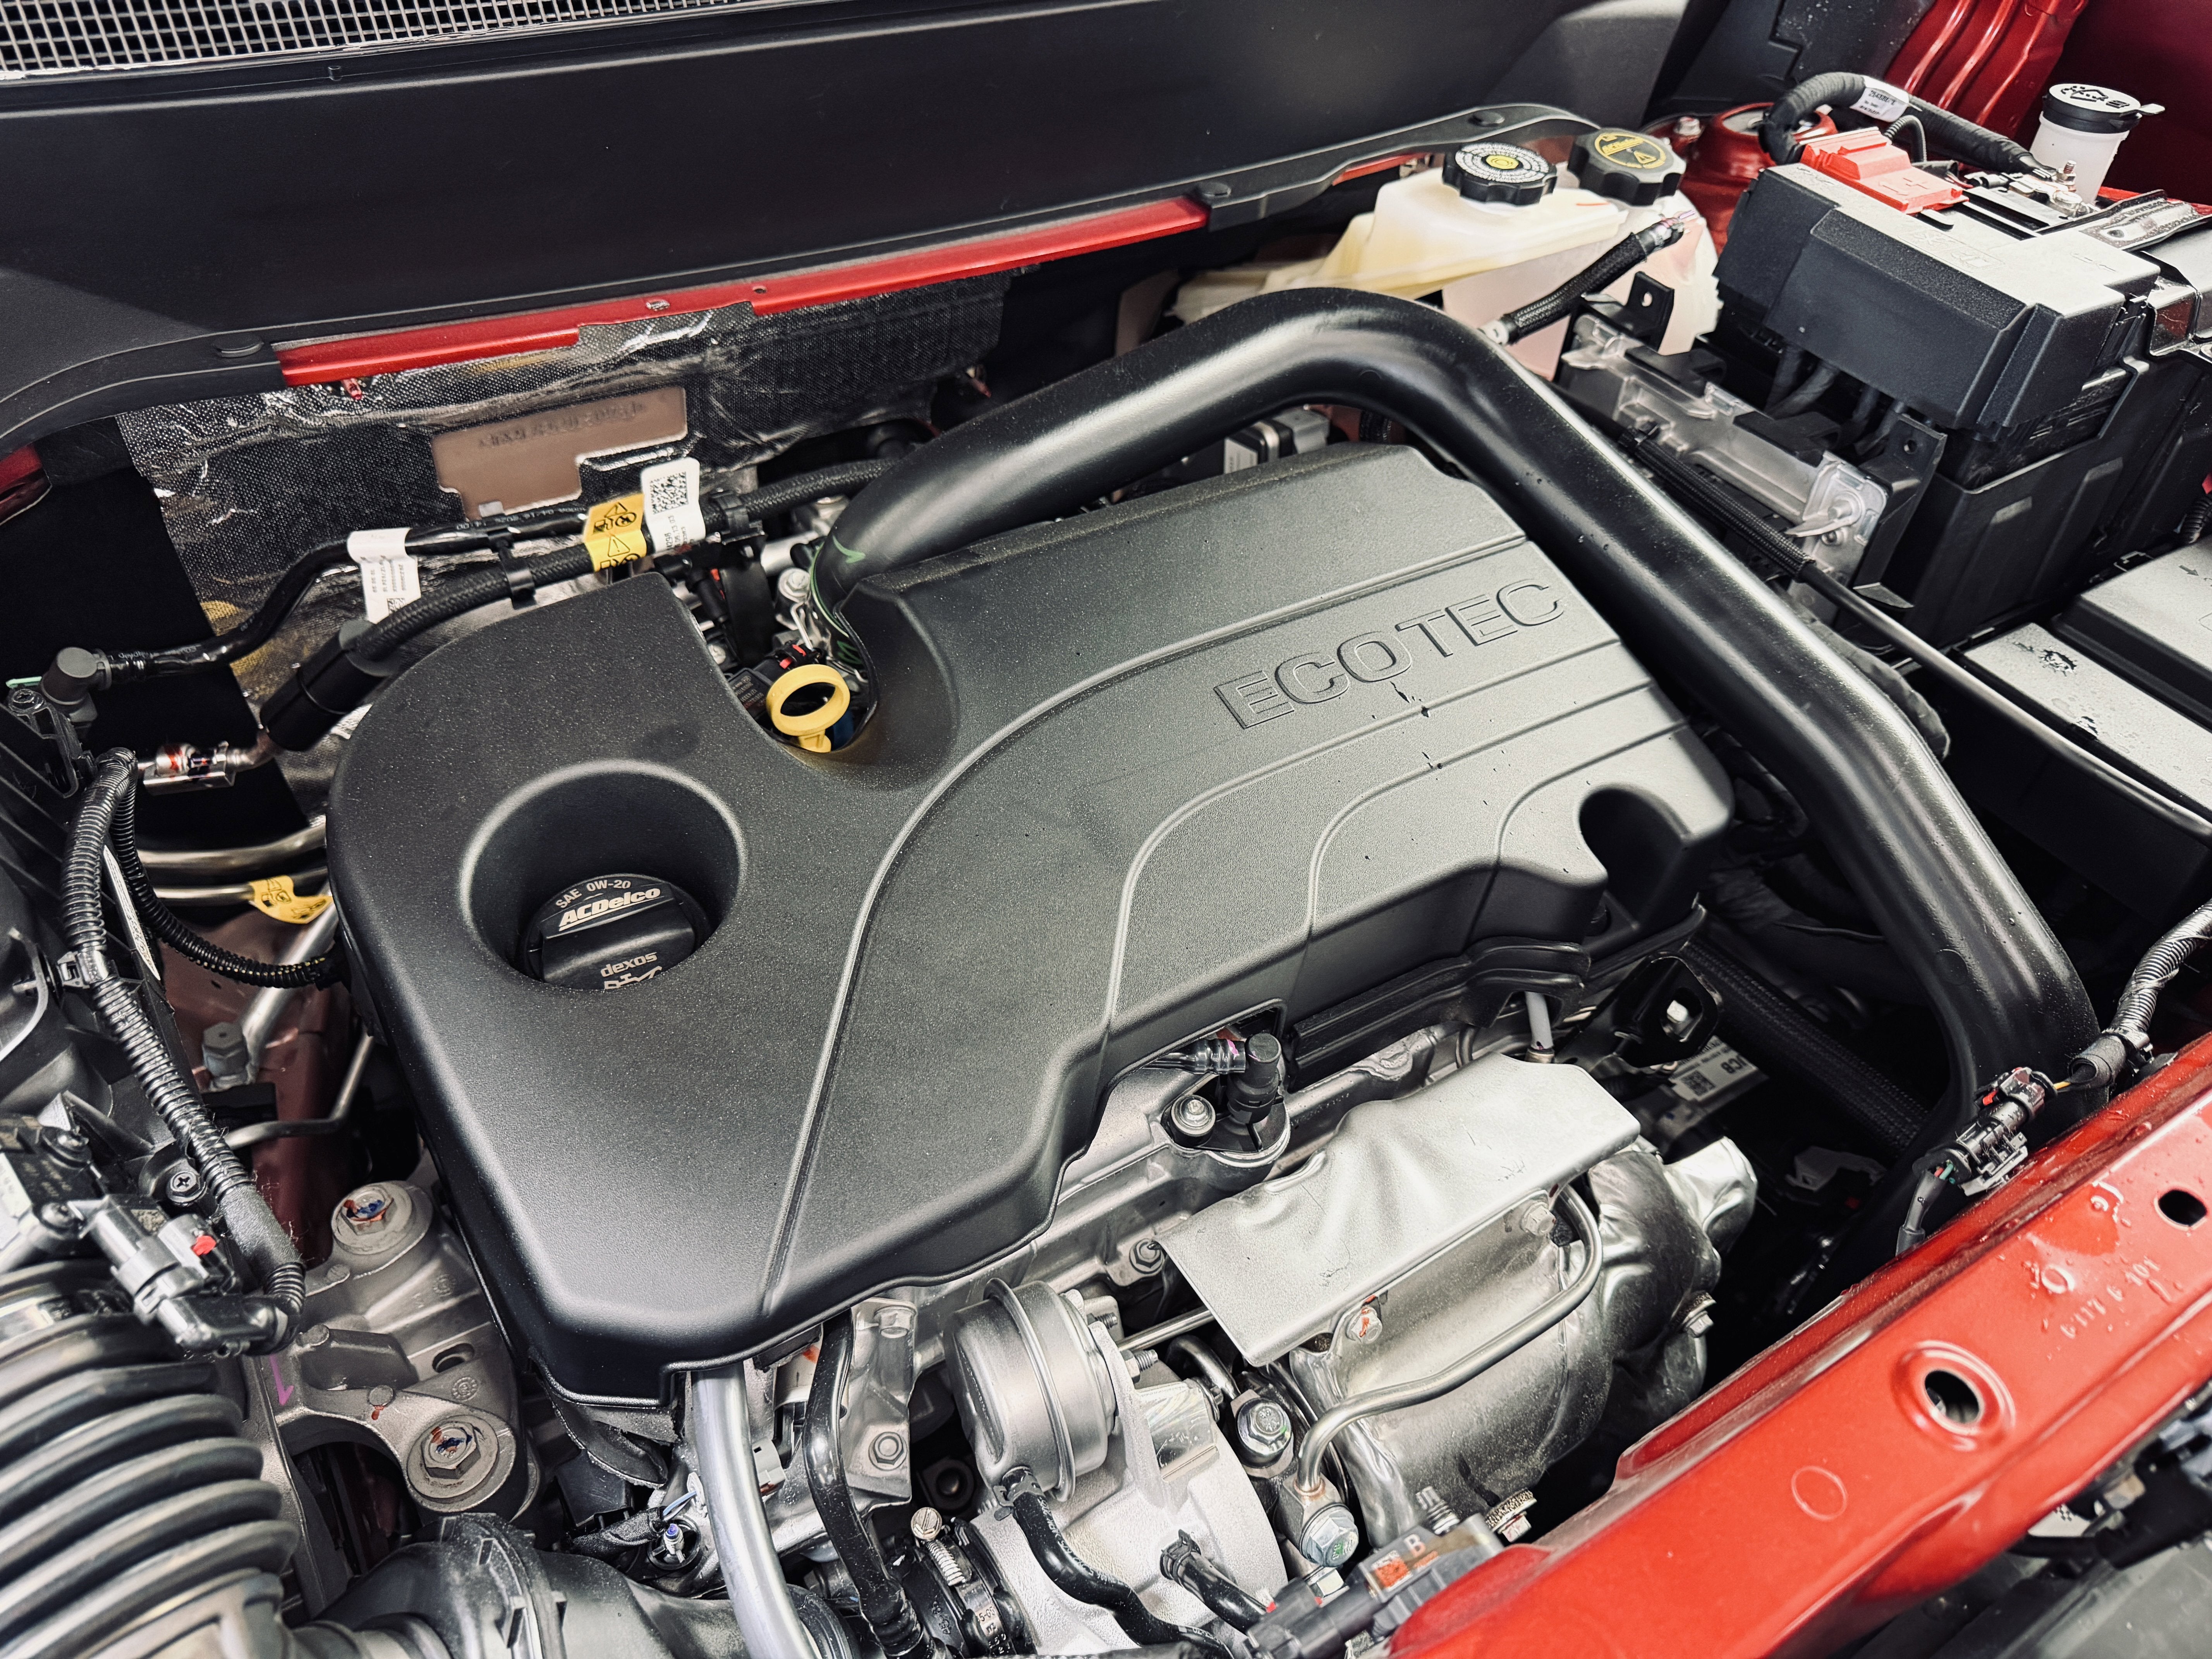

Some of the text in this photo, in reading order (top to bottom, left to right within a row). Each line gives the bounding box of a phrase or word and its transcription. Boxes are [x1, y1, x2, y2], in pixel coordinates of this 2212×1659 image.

[1214, 579, 1565, 730] ECOTEC
[556, 879, 631, 908] SAE 0W-20
[558, 888, 661, 929] ACDelco
[600, 951, 658, 977] dexos
[1403, 1534, 1426, 1558] B
